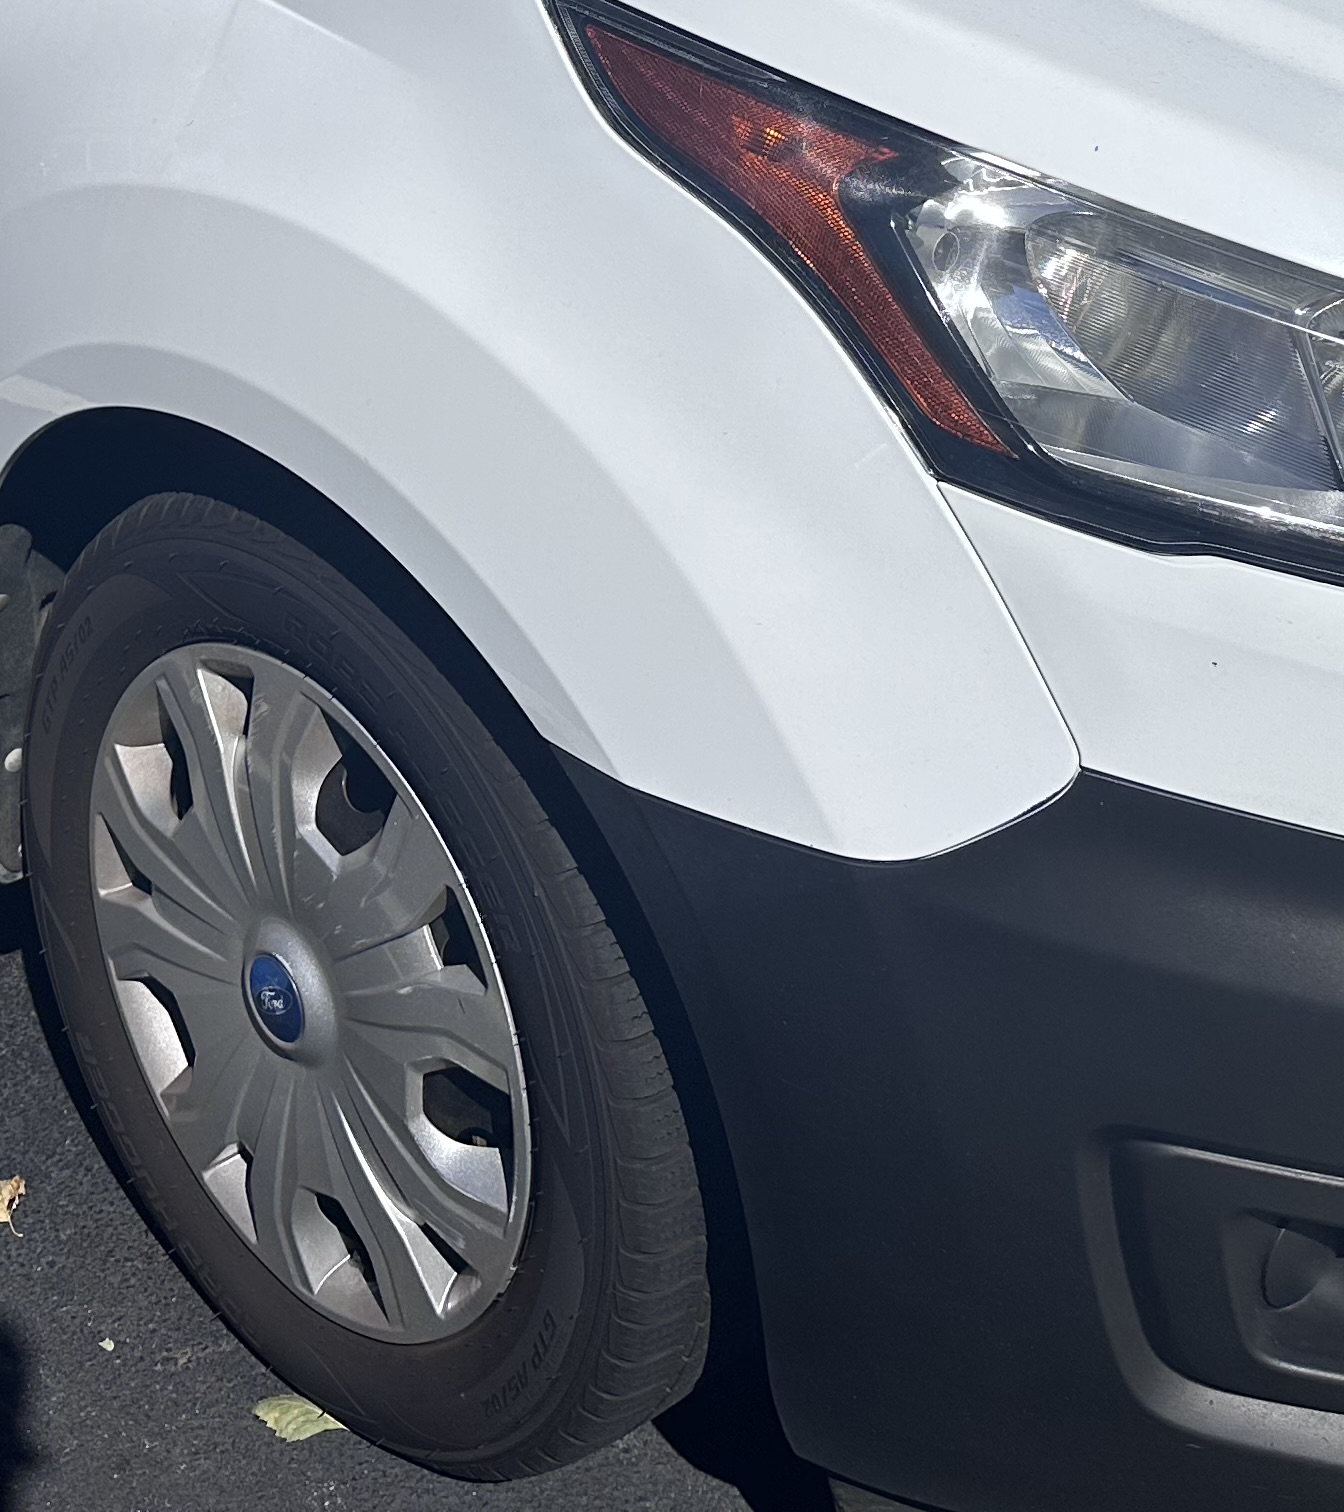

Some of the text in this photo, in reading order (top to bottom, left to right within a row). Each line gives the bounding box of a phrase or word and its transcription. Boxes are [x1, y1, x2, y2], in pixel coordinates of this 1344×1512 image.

[41, 616, 93, 734] GTP AS/02
[260, 990, 284, 1009] Ford
[75, 1031, 180, 1232] HUGGER
[480, 1308, 557, 1418] GTP AS/02
